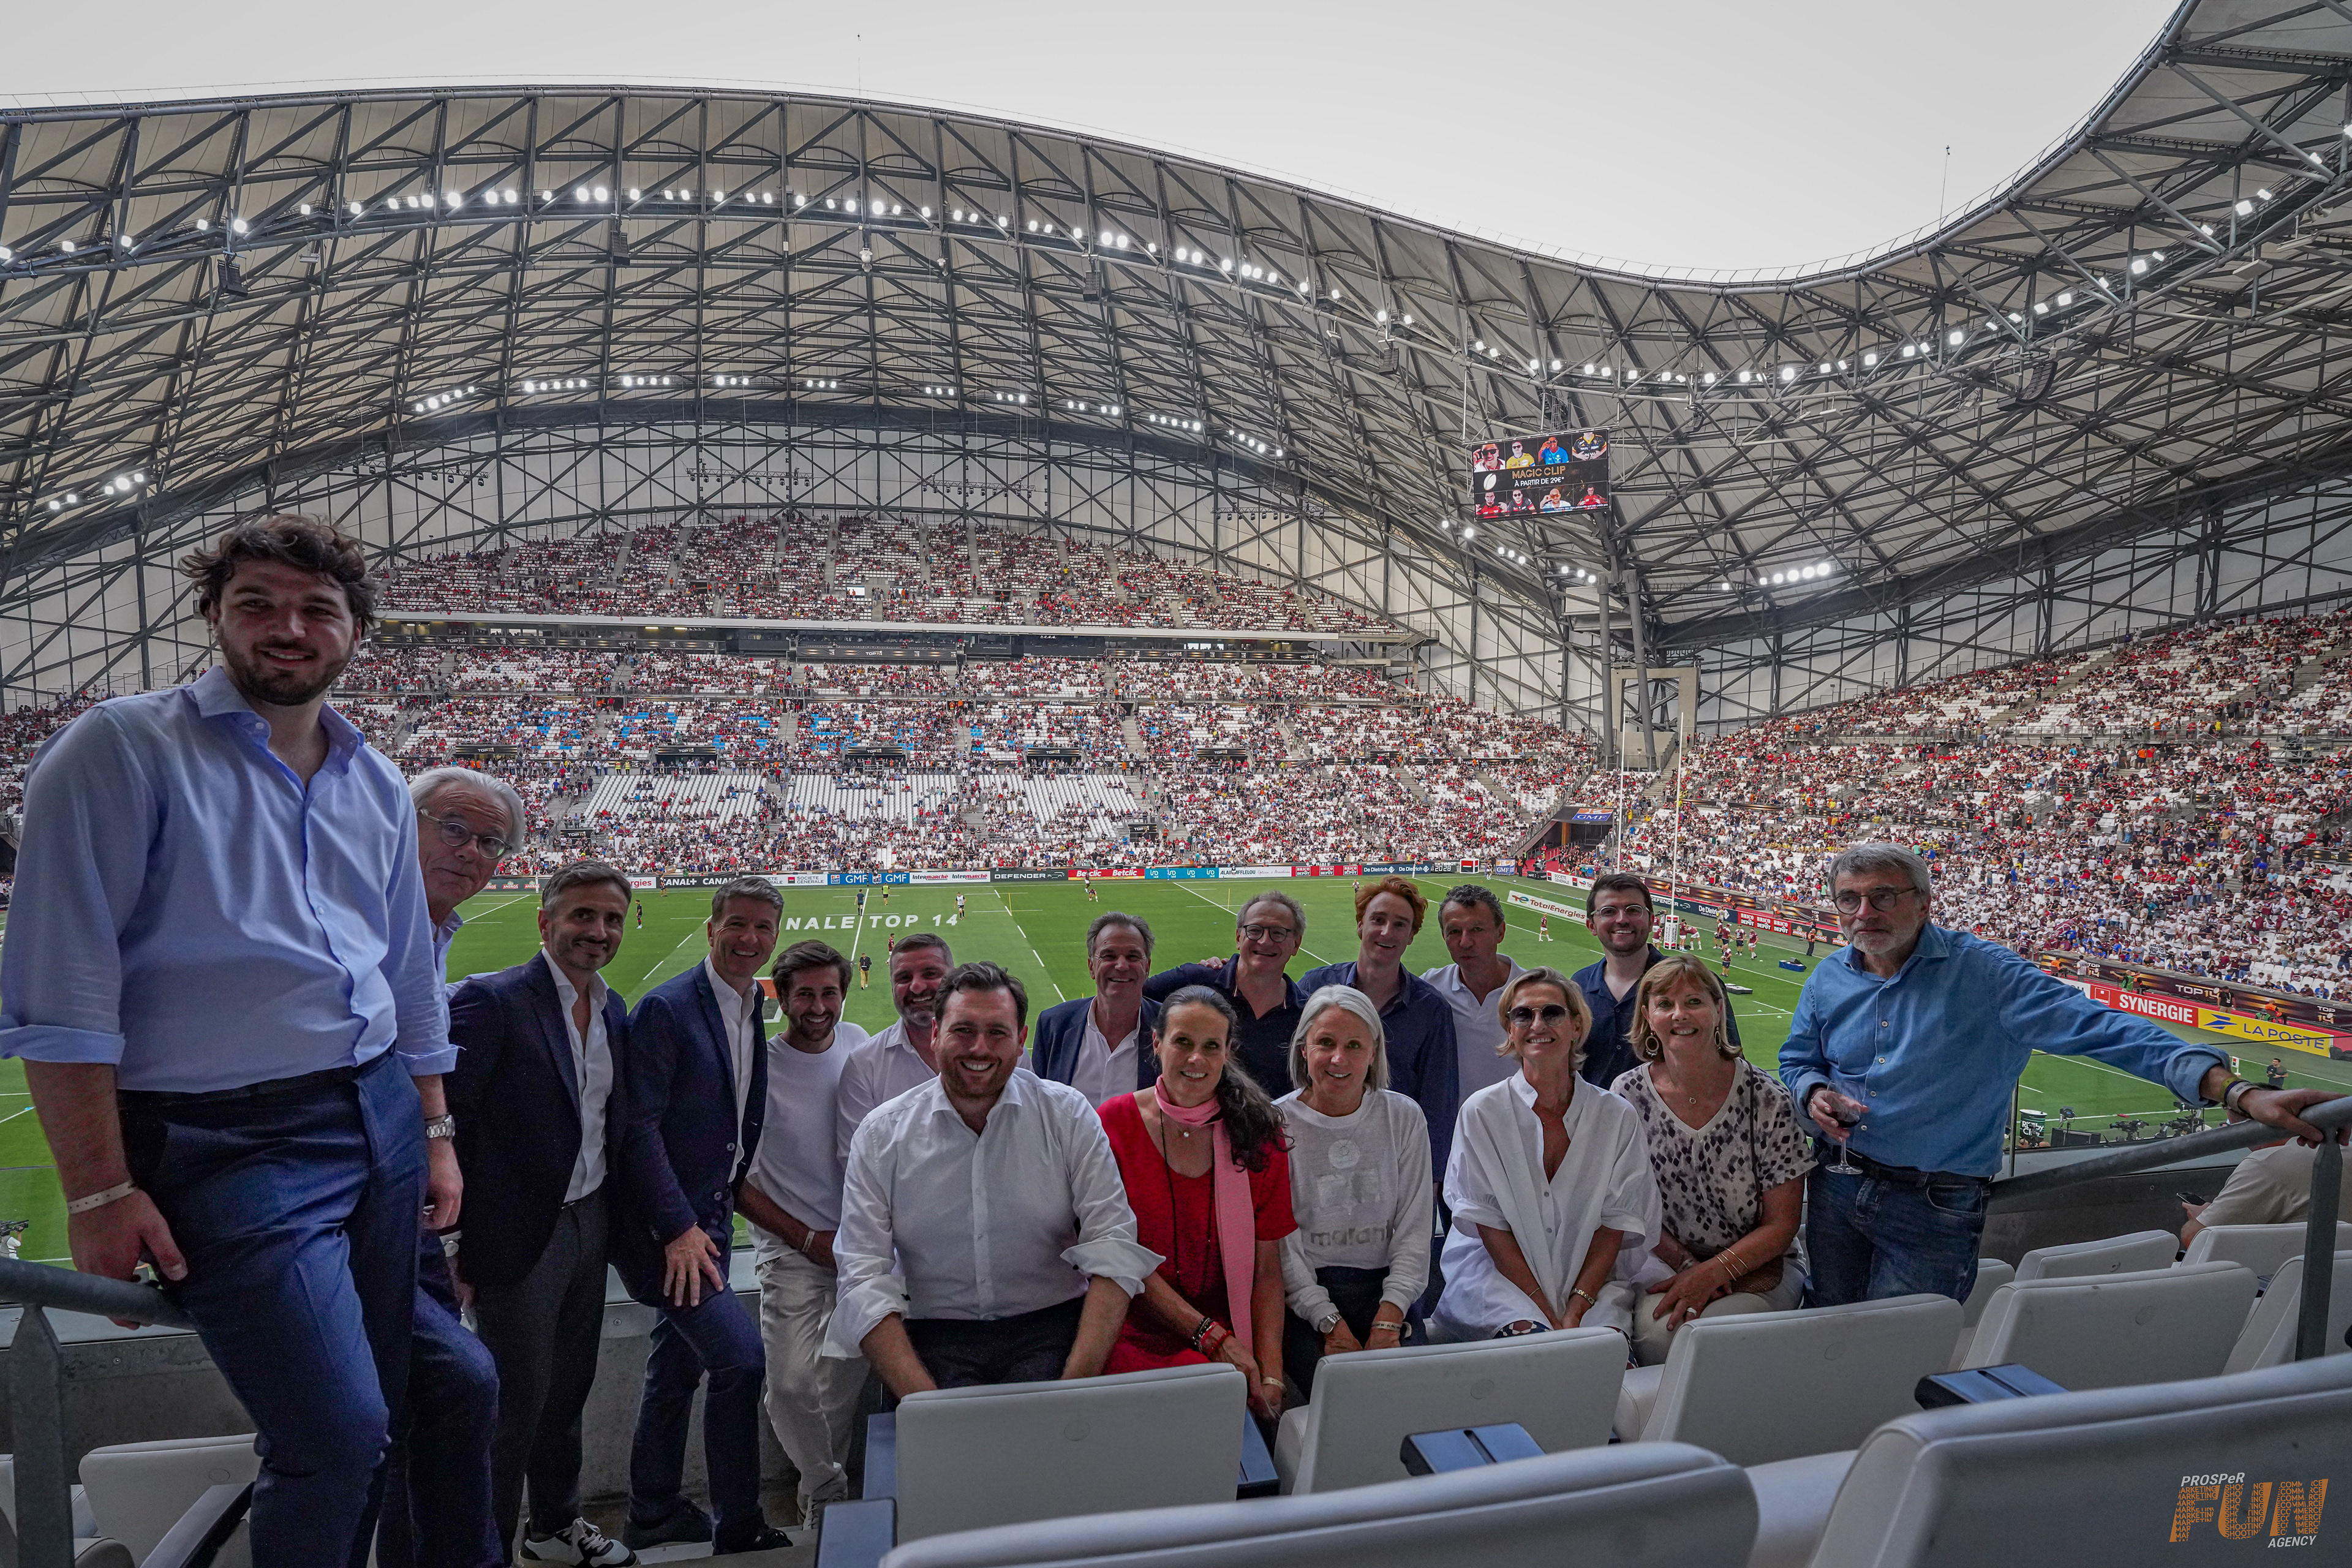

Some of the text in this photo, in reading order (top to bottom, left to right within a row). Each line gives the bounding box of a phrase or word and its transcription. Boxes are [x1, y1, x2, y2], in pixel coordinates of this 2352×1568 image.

[1512, 466, 1566, 480] MAGIC CLIP
[845, 874, 867, 883] GMF
[885, 874, 907, 883] GMF
[1530, 899, 1586, 919] TotalEnergies
[785, 914, 957, 930] NALE TOP 14
[2175, 984, 2220, 1000] TOP14
[2119, 994, 2193, 1023] SYNERGIE
[2317, 1014, 2334, 1024] 14
[2244, 1023, 2324, 1050] LA POSTE
